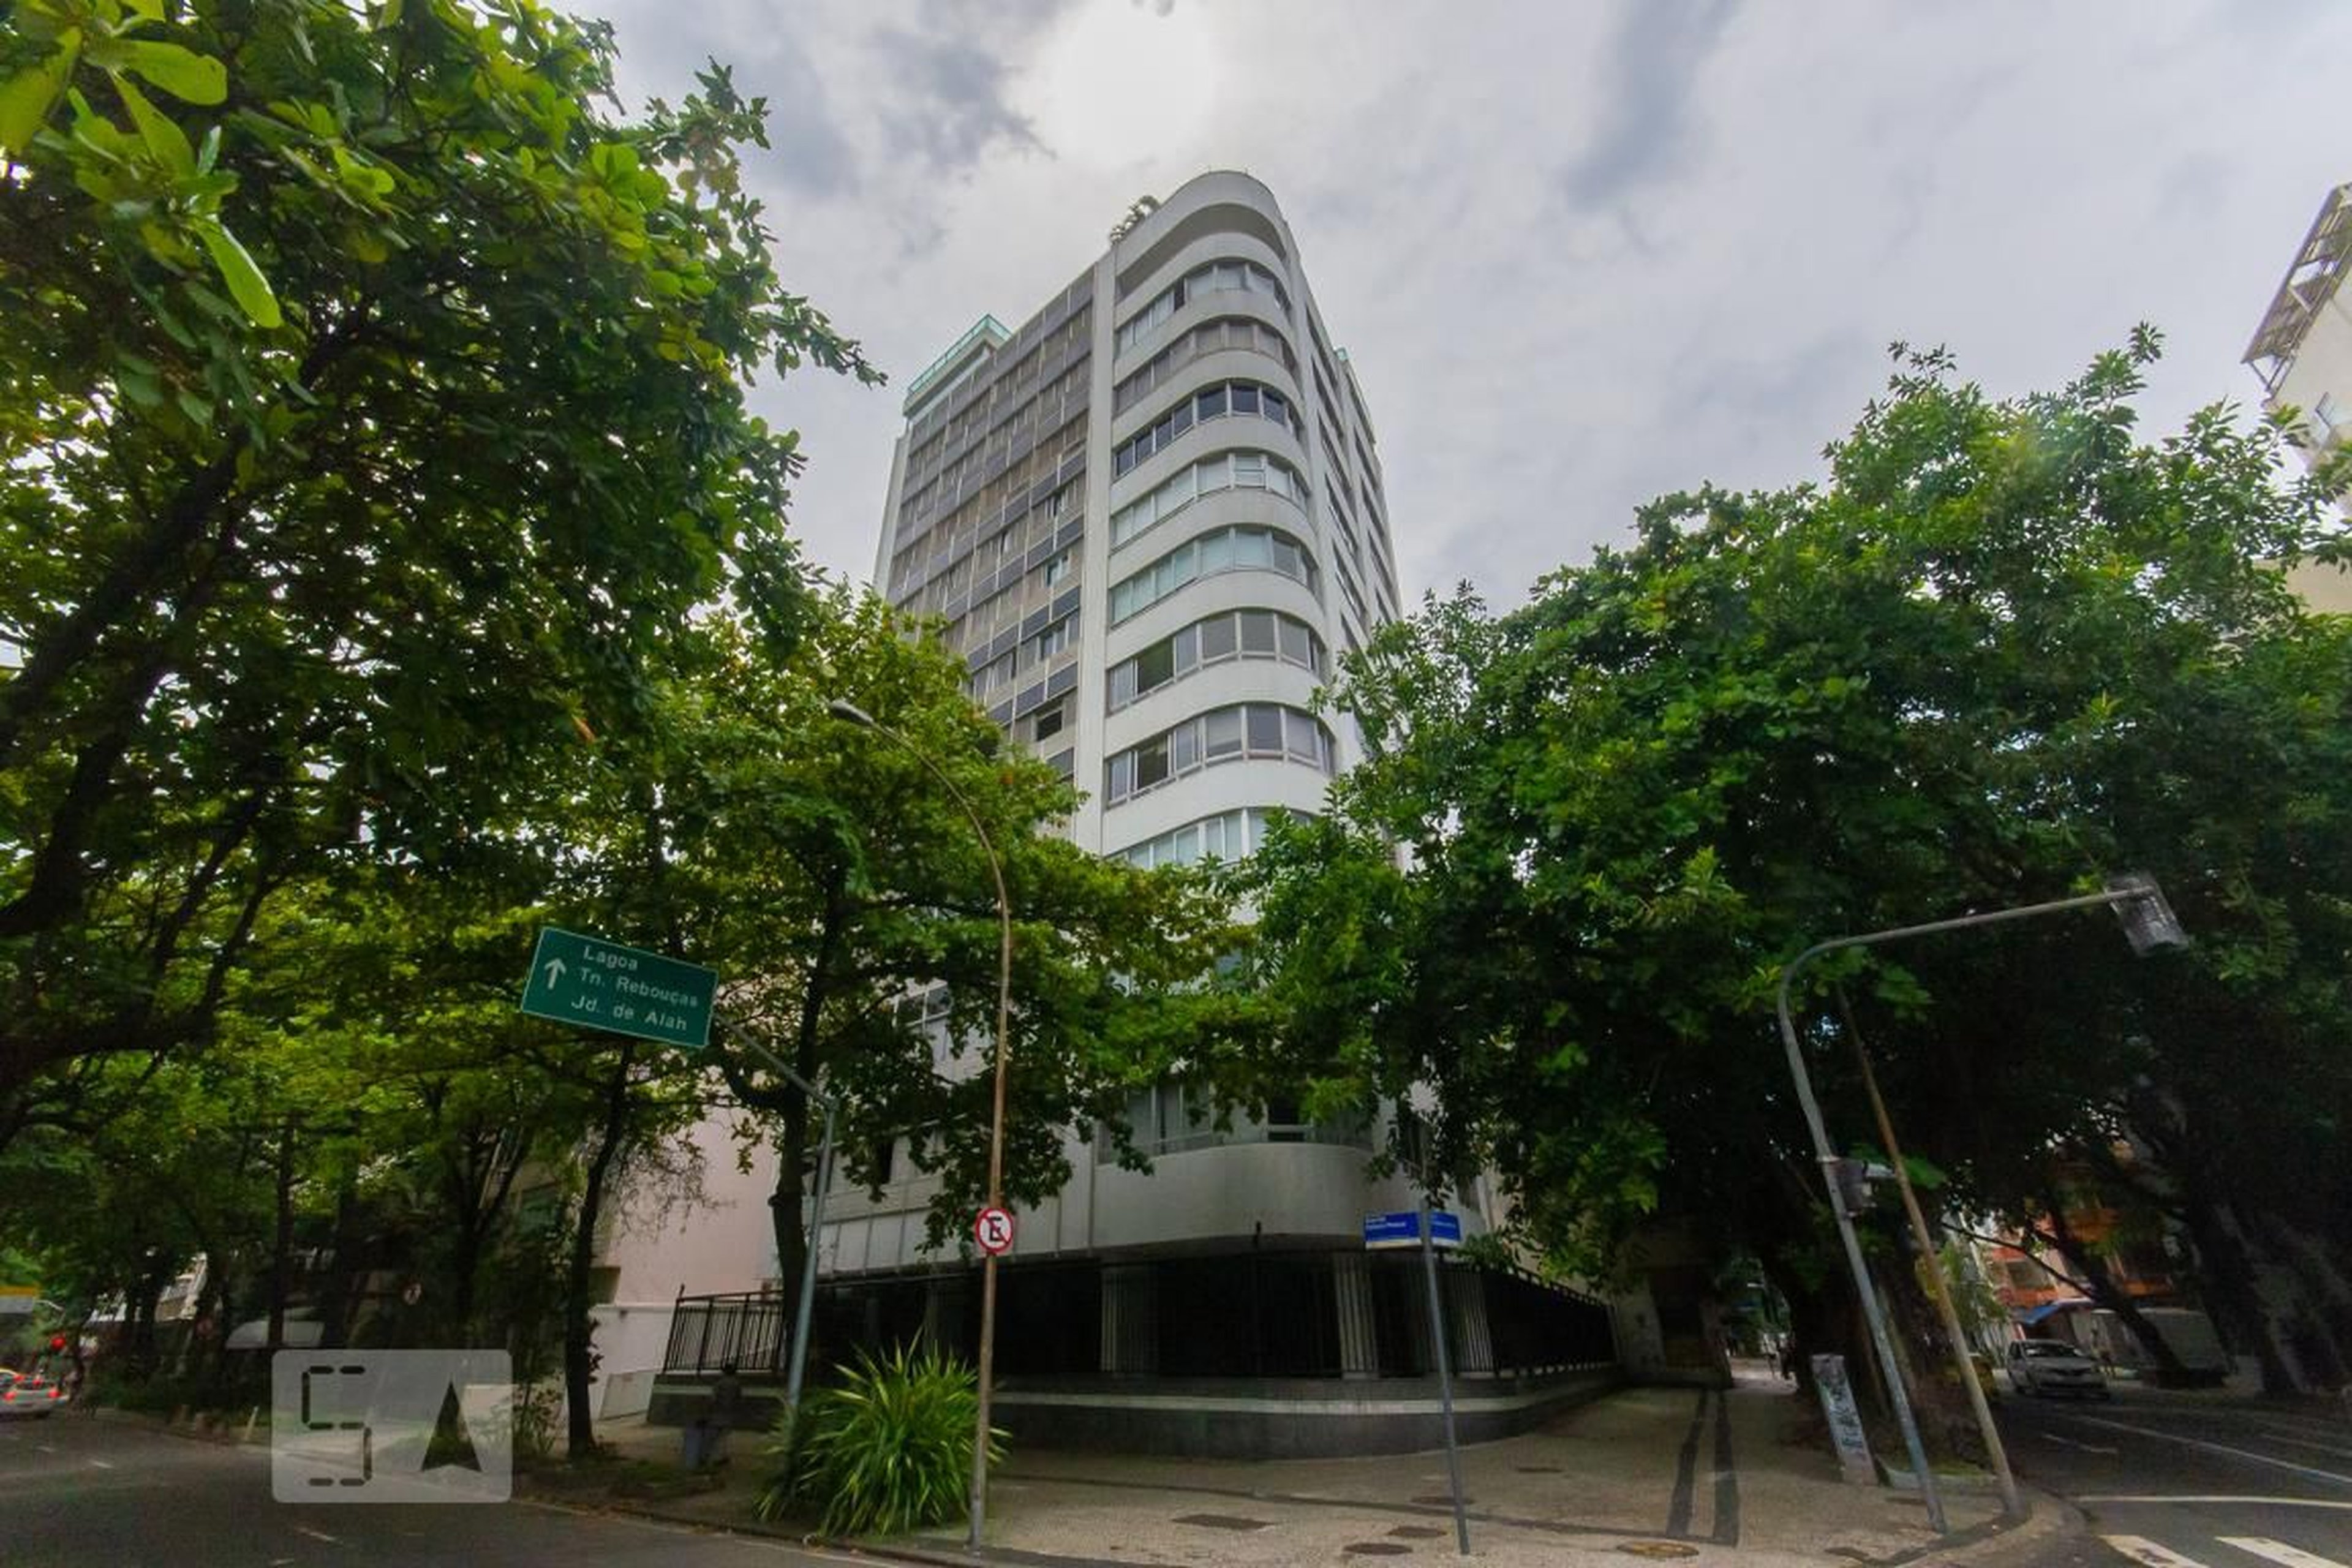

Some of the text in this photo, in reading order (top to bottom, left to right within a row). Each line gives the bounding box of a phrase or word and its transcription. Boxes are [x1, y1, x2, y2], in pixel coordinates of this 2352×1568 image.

[583, 945, 638, 971] Lagoa
[580, 968, 698, 1006] Tn. Rebouças
[571, 995, 687, 1030] Jd. de Alah
[989, 1216, 1003, 1241] E
